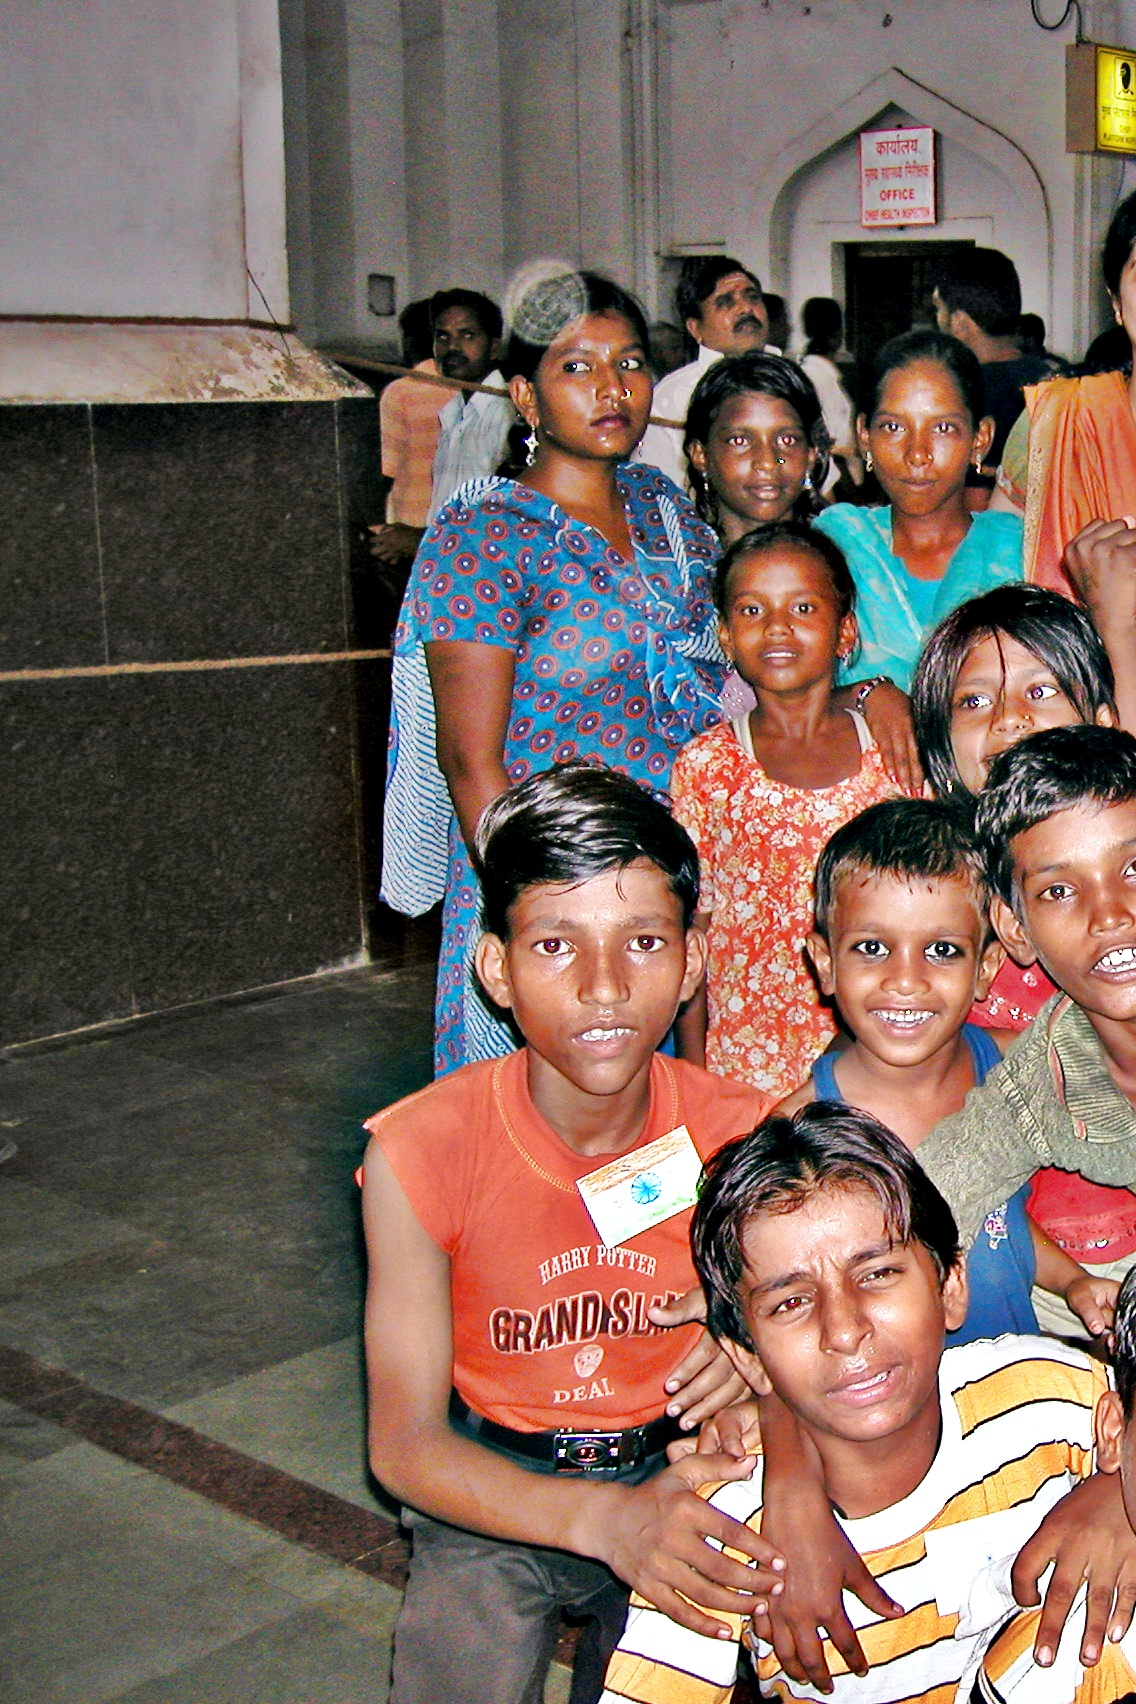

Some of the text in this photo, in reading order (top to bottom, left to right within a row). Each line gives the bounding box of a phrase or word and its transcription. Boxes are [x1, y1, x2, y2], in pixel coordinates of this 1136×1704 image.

[875, 134, 918, 155] कार्यालय
[880, 188, 915, 201] OFFICE
[538, 1244, 658, 1285] HARRY POTTER
[489, 1290, 604, 1354] GRAND
[553, 1377, 615, 1404] DEAL
